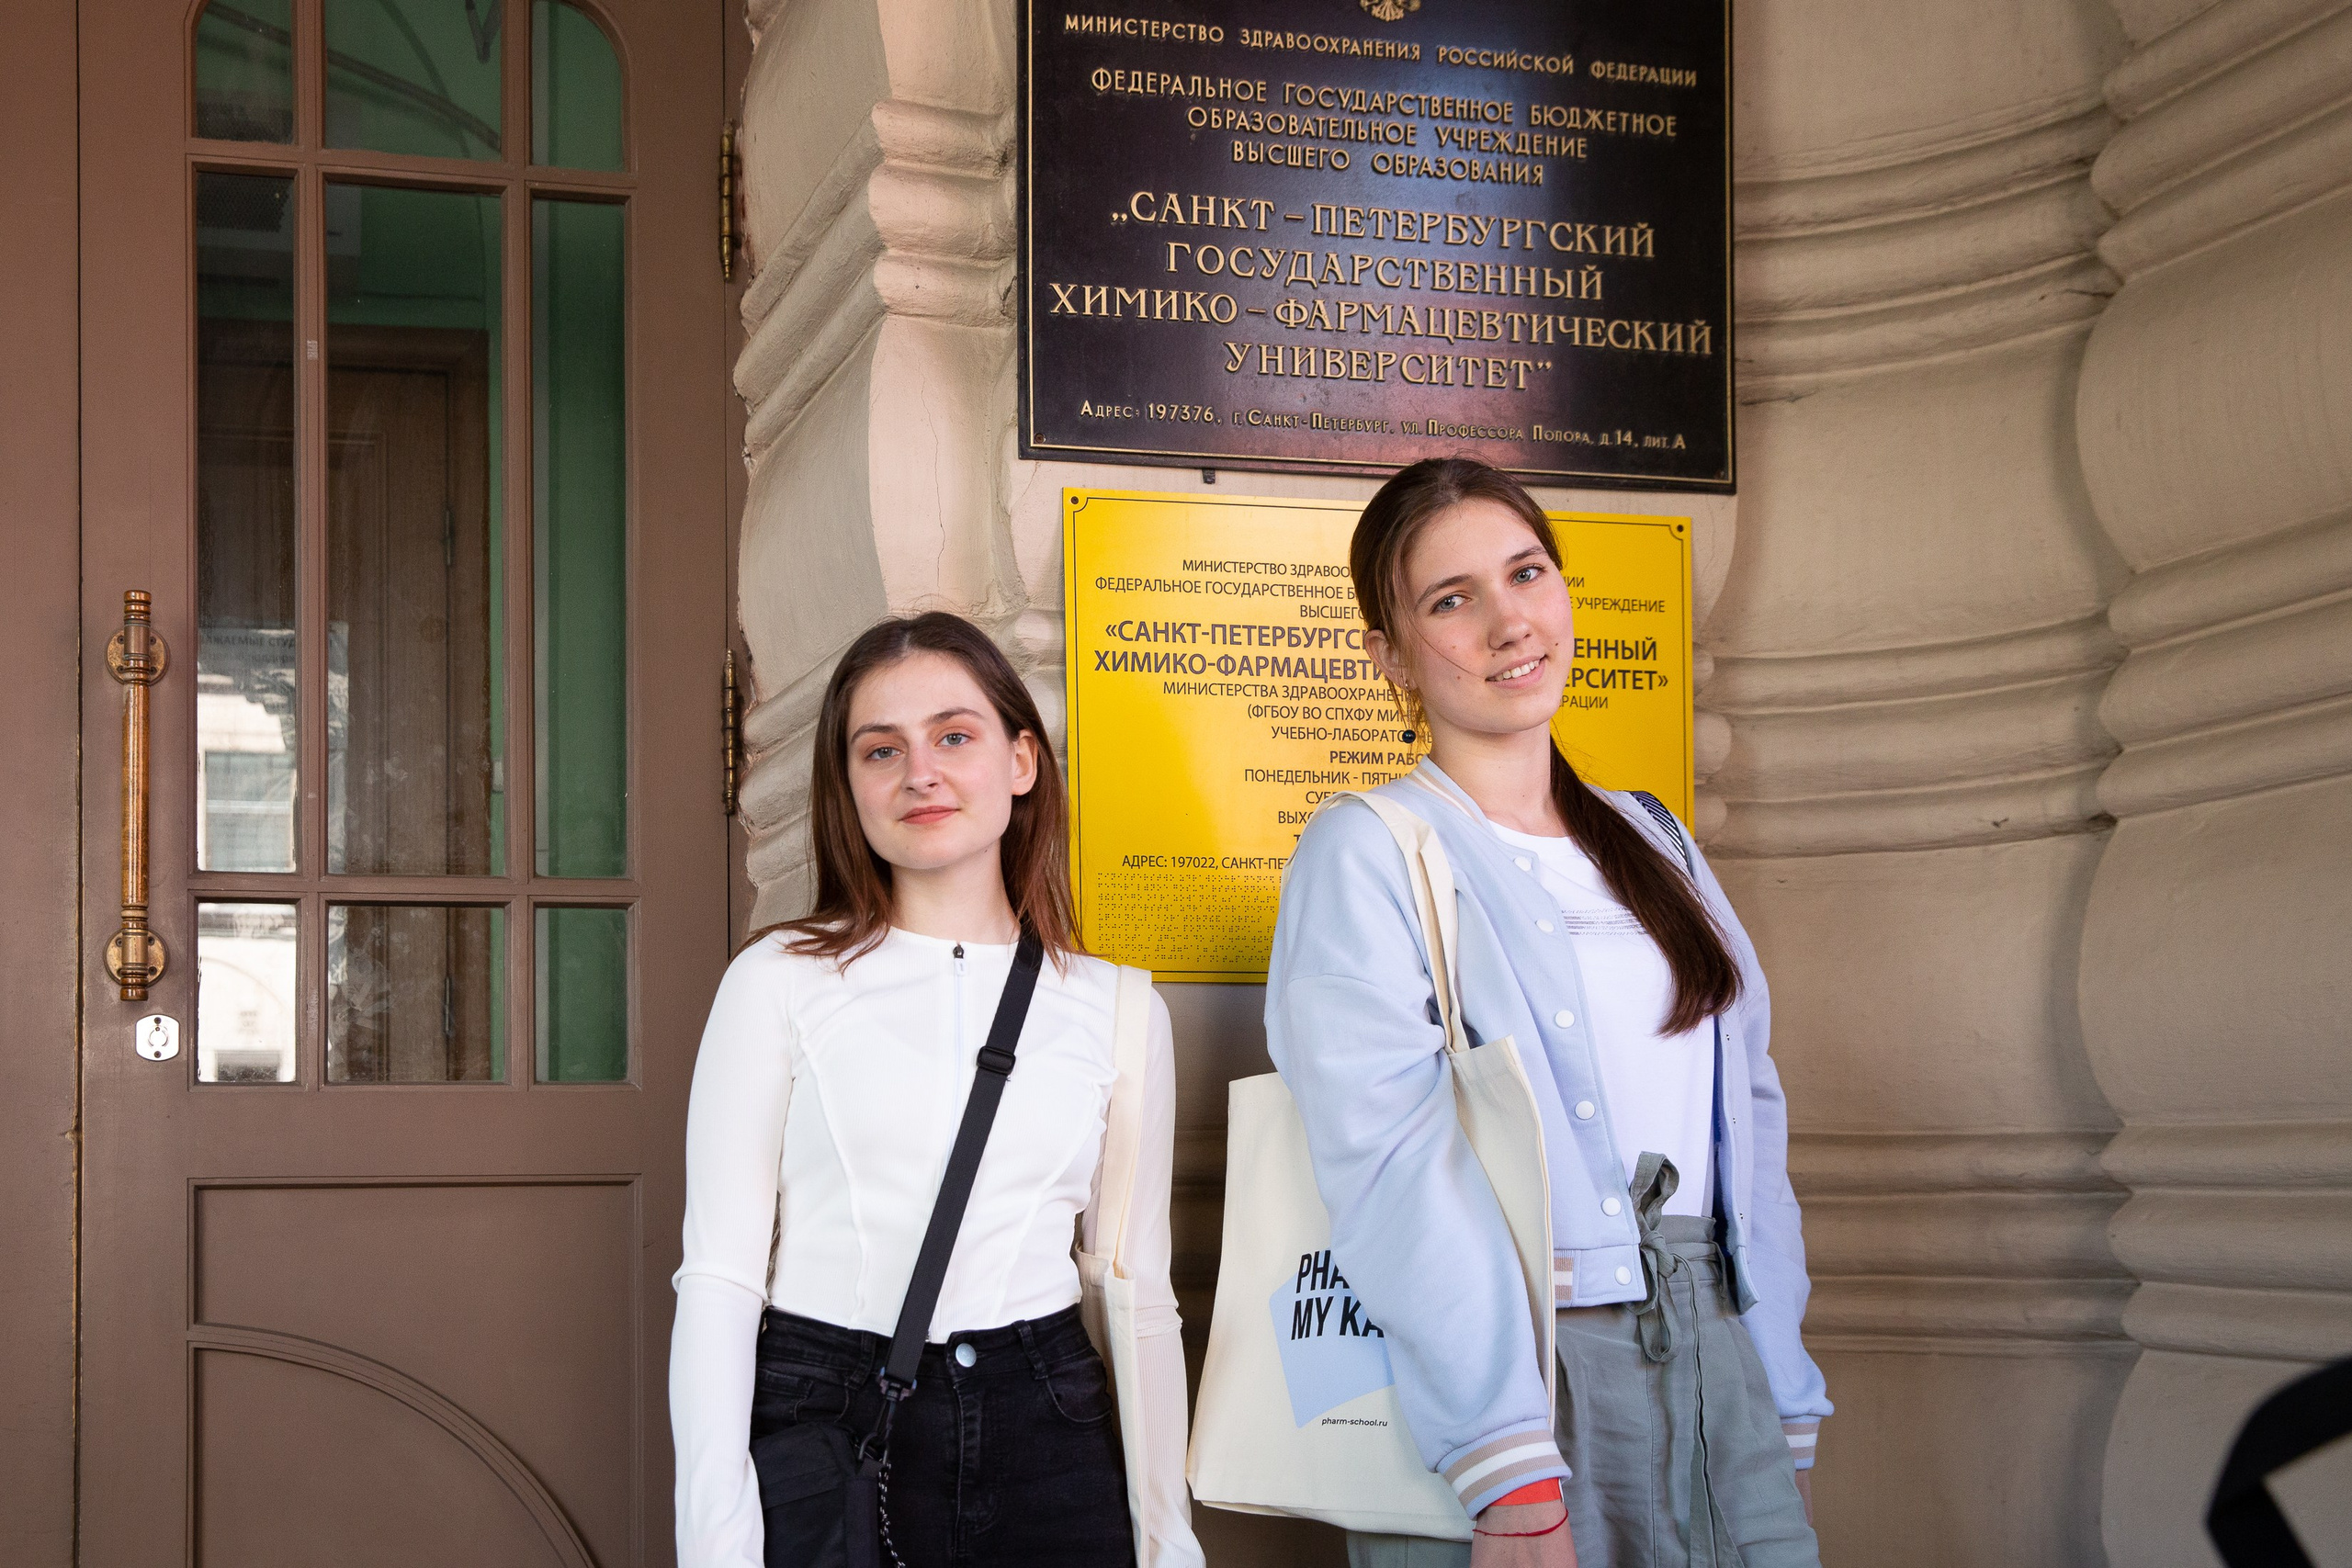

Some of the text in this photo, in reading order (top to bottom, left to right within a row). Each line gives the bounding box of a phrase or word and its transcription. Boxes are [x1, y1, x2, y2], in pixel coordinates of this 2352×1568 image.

[1065, 14, 1697, 88] МИНИСТЕРСТВО ЗДРАВООХРАНЕНИЯ РОССИЙСКОЙ ФЕДЕРАЦИИ
[1091, 67, 1678, 137] ФЕДЕРАЛЬНОЕ ГОСУДАРСТВЕННОЕ БЮДЖЕТНОЕ
[1187, 107, 1588, 158] ОБРАЗОВАТЕЛЬНОЕ УЧРЕЖДЕНИЕ
[1232, 141, 1544, 186] ВЫСШЕГО ОБРАЗОВАНИЯ
[1166, 241, 1604, 301] ГОСУДАРСТВЕННЫЙ
[1182, 559, 1351, 578] МИНИСТЕРСТВО ЗДРАВОО
[1095, 576, 1202, 594] ФЕДЕРАЛЬНОЕ
[1205, 581, 1343, 599] ГОСУДАРСТВЕННОЕ
[1577, 597, 1666, 614] УЧРЕЖДЕНИЕ
[1105, 620, 1657, 661] «САНКТ-ПЕТЕРБУРГС ЕННЫЙ
[1163, 682, 1278, 699] МИНИСТЕРСТВА
[1248, 704, 1299, 720] (ФГБОУ
[1302, 706, 1322, 719] ВО
[1325, 707, 1374, 722] СПХФУ
[1329, 750, 1384, 764] РЕЖИМ
[1245, 769, 1351, 786] ПОНЕДЕЛЬНИК
[1122, 854, 1288, 871] АДРЕС: 197022, САНКТ-ПЕ
[1291, 1296, 1334, 1340] MY
[1321, 1417, 1388, 1427] pharm-school.ru
